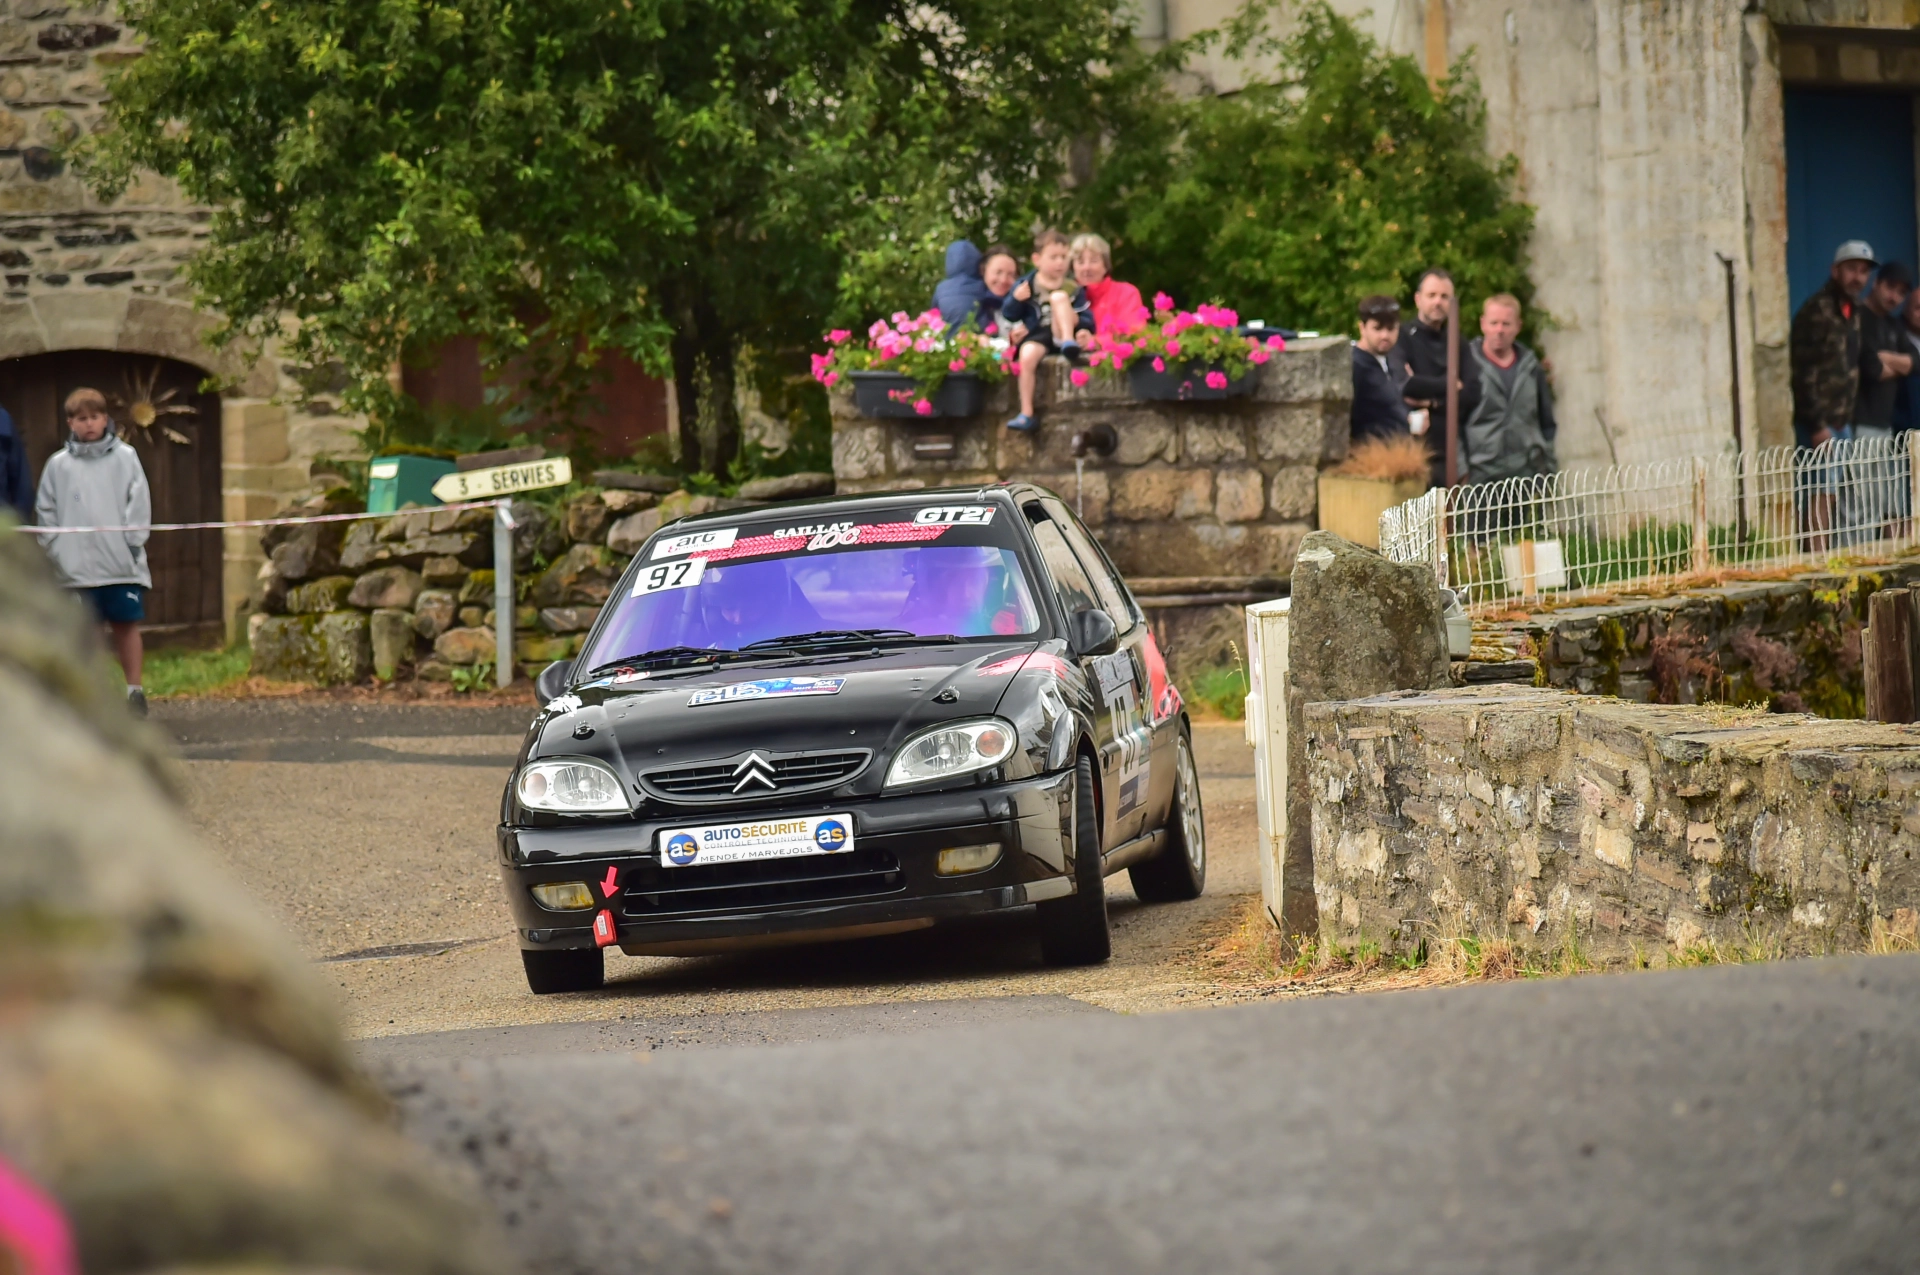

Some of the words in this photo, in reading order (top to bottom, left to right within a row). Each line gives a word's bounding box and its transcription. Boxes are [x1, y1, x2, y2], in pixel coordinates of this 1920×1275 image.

[459, 476, 469, 495] 3
[491, 463, 556, 491] SERVIES
[774, 522, 853, 539] SAILLAT
[807, 530, 861, 551] LOC
[647, 561, 692, 590] 97
[756, 834, 808, 845] TECHNIQUE
[818, 828, 844, 844] as
[670, 840, 696, 858] as
[701, 853, 738, 862] MENDE
[748, 846, 813, 858] MARVEJOLS
